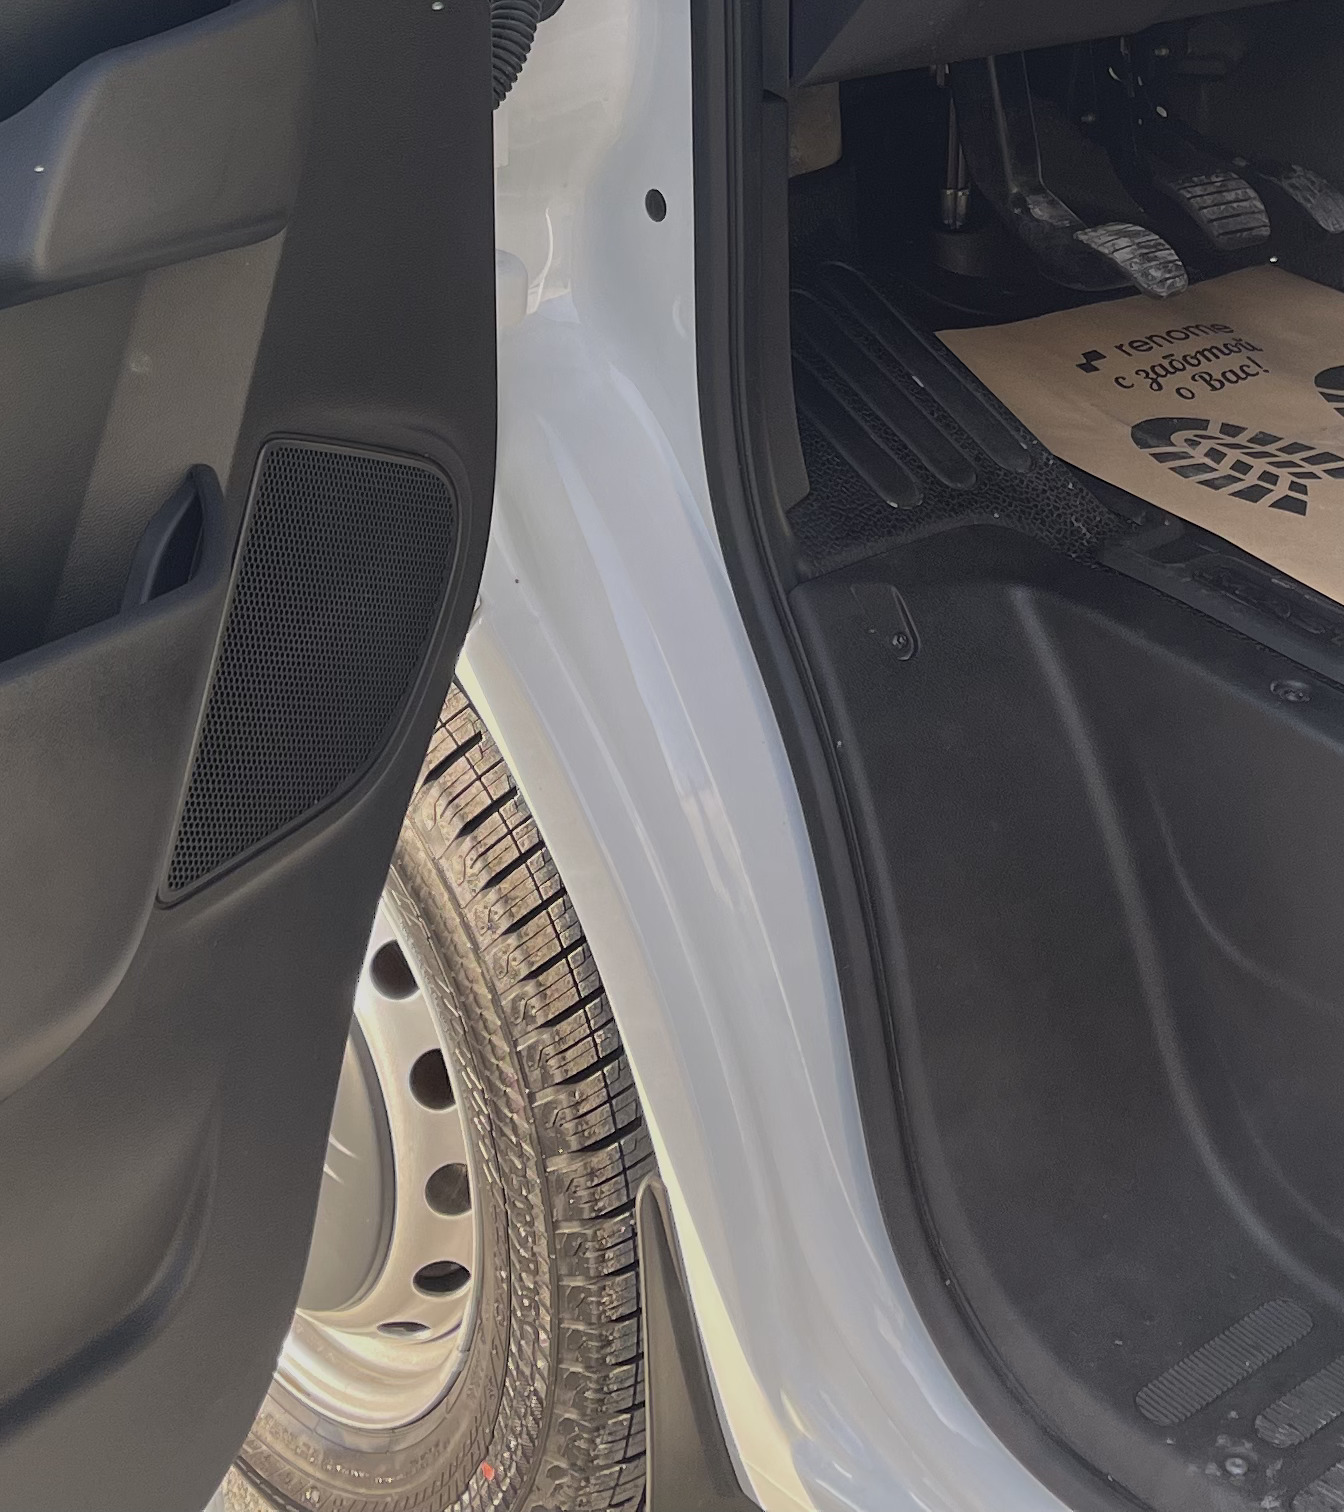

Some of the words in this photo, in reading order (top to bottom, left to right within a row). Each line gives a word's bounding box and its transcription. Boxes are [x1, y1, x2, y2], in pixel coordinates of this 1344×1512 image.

[1114, 323, 1235, 357] renome
[1113, 375, 1135, 389] с
[1135, 338, 1263, 392] заботой
[1175, 386, 1196, 400] о
[1191, 355, 1270, 392] Вас!
